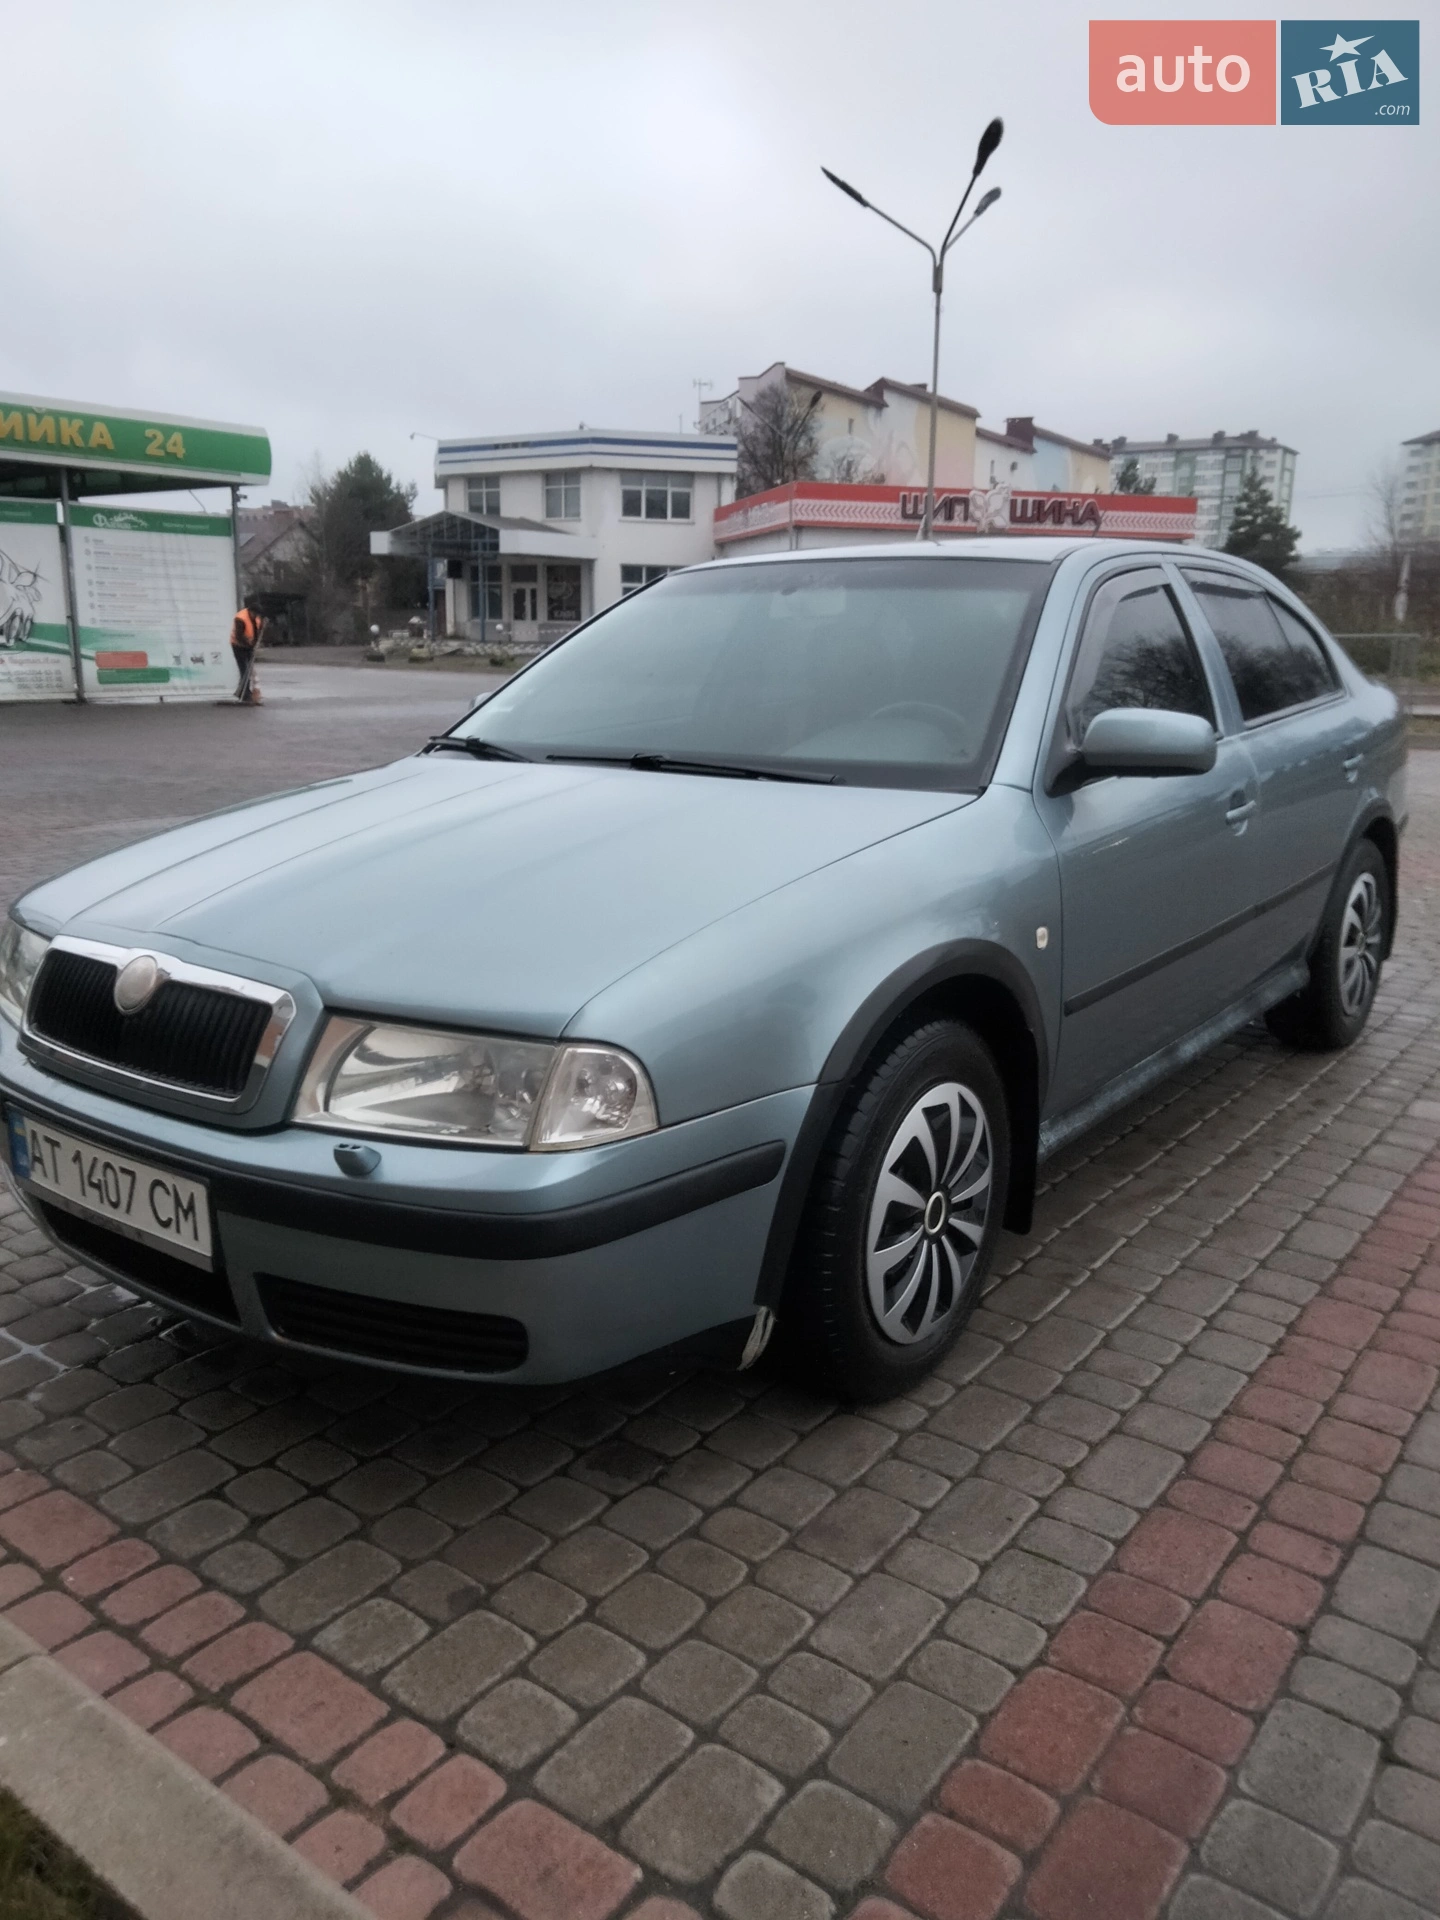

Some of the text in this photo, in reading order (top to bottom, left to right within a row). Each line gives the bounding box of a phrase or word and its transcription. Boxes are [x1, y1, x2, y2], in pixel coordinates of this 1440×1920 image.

[144, 428, 185, 459] 24
[1009, 497, 1101, 526] ШИНА
[30, 1129, 199, 1241] AT 1407 CM
